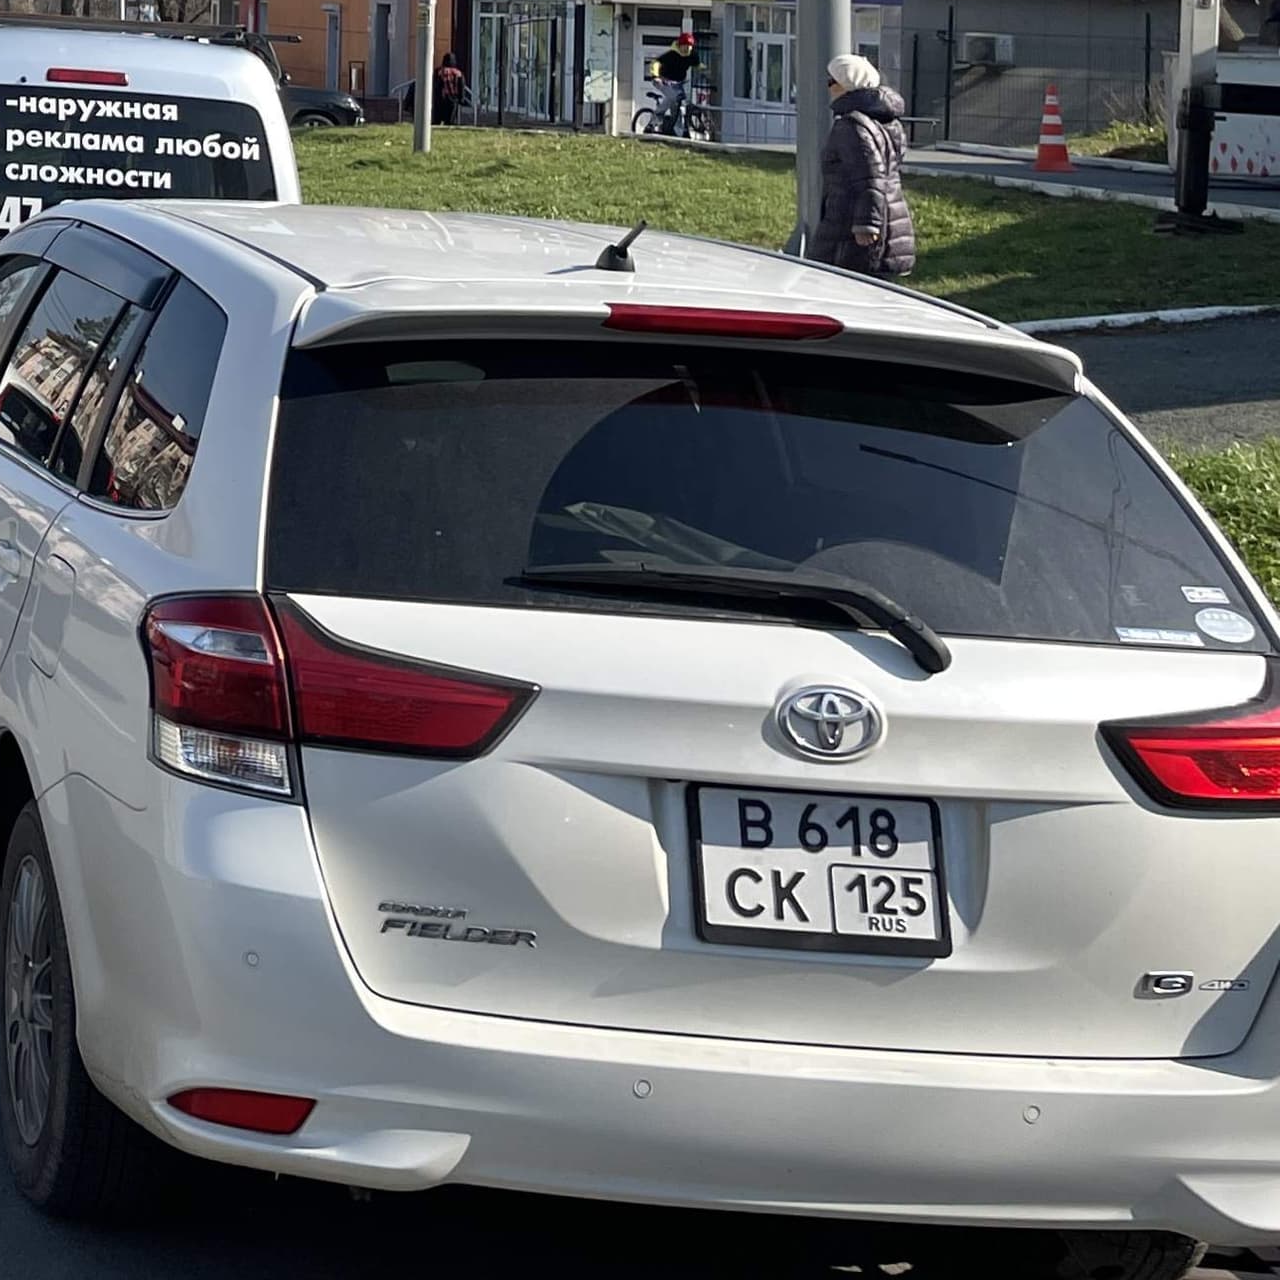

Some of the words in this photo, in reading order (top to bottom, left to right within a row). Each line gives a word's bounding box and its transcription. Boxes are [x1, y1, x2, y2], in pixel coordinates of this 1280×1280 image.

[5, 96, 179, 122] -наружная
[6, 128, 145, 154] реклама
[156, 133, 261, 161] любой
[5, 163, 172, 190] сложности
[798, 803, 899, 858] 618
[845, 874, 926, 917] 125
[380, 919, 537, 949] FIELDER
[868, 917, 907, 933] RUS
